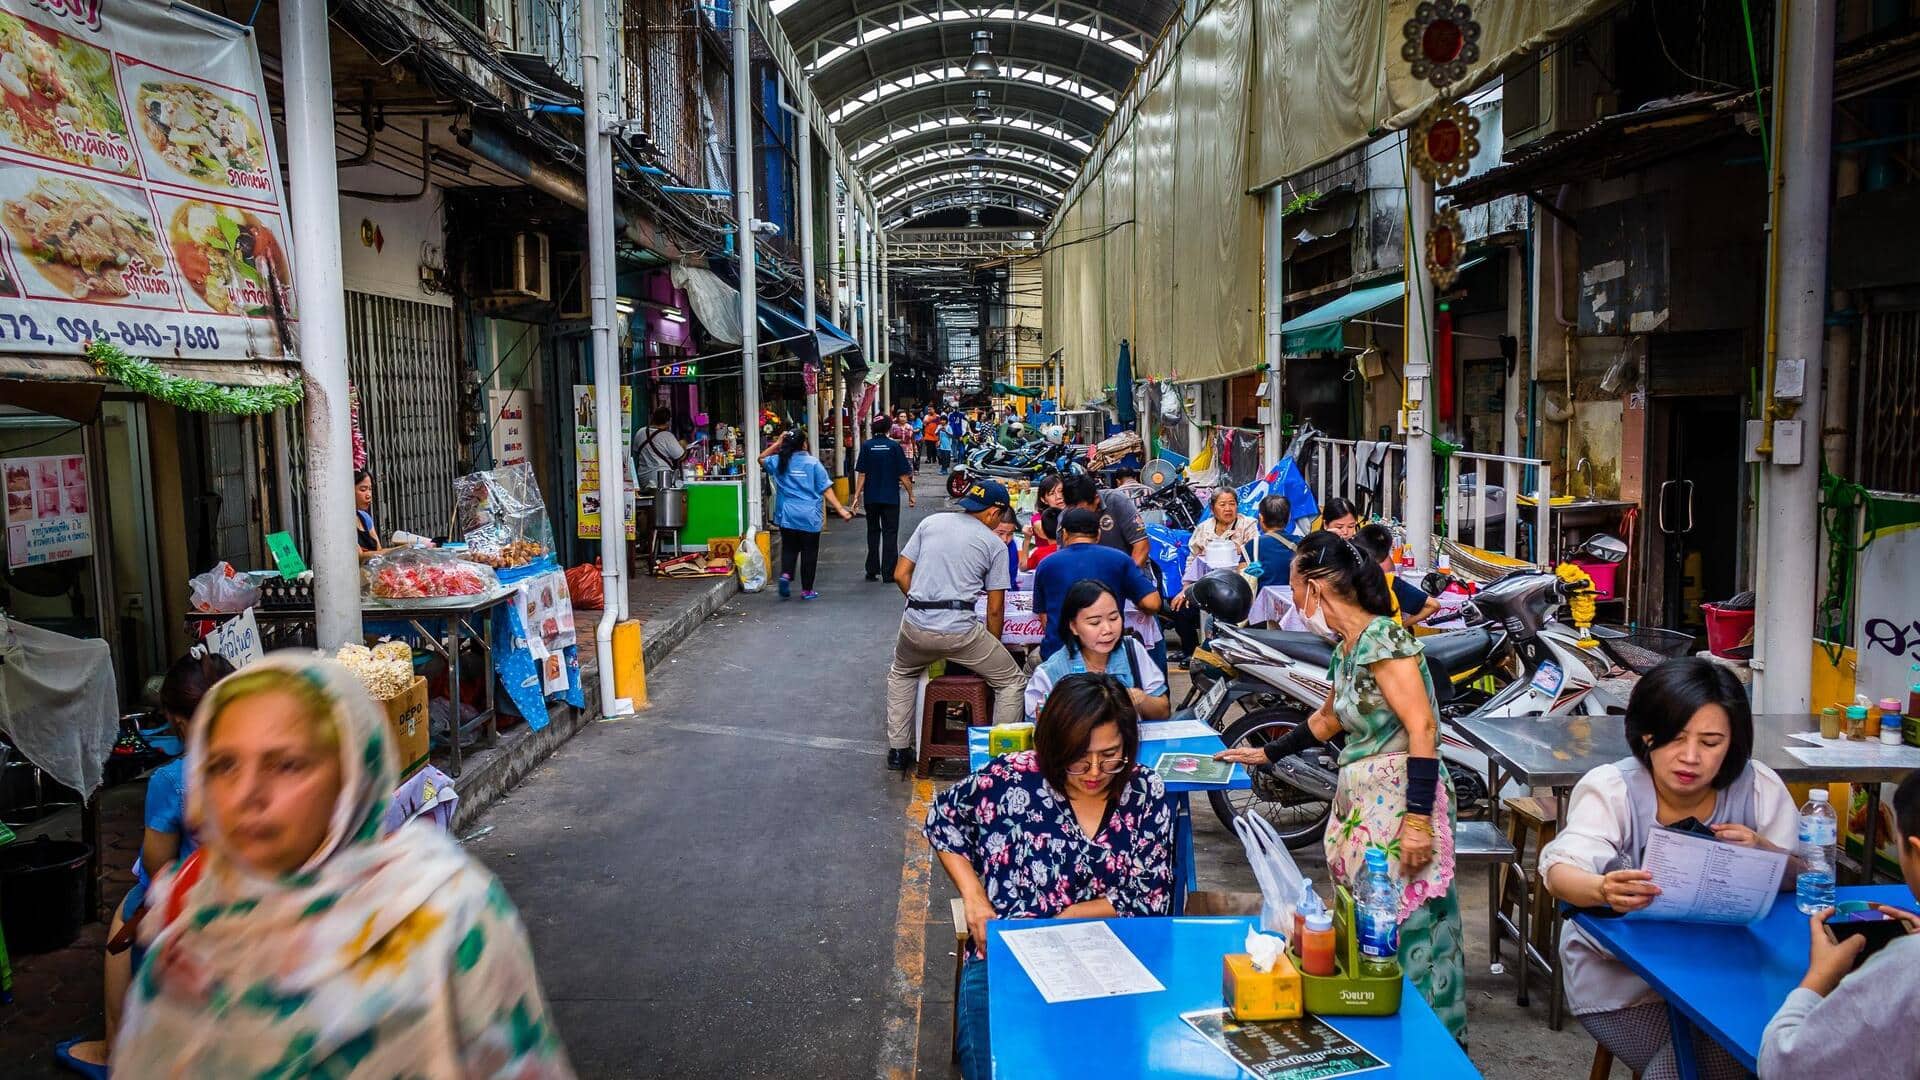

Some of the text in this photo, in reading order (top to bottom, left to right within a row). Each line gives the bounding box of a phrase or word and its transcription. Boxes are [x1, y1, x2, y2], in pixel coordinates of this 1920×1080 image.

[56, 117, 129, 169] ข้าวผัดกุ้ง
[227, 168, 272, 192] ราดหน้า
[0, 313, 220, 350] 72, 096-840-7680
[663, 366, 696, 376] OPEN
[400, 703, 422, 725] DEPO
